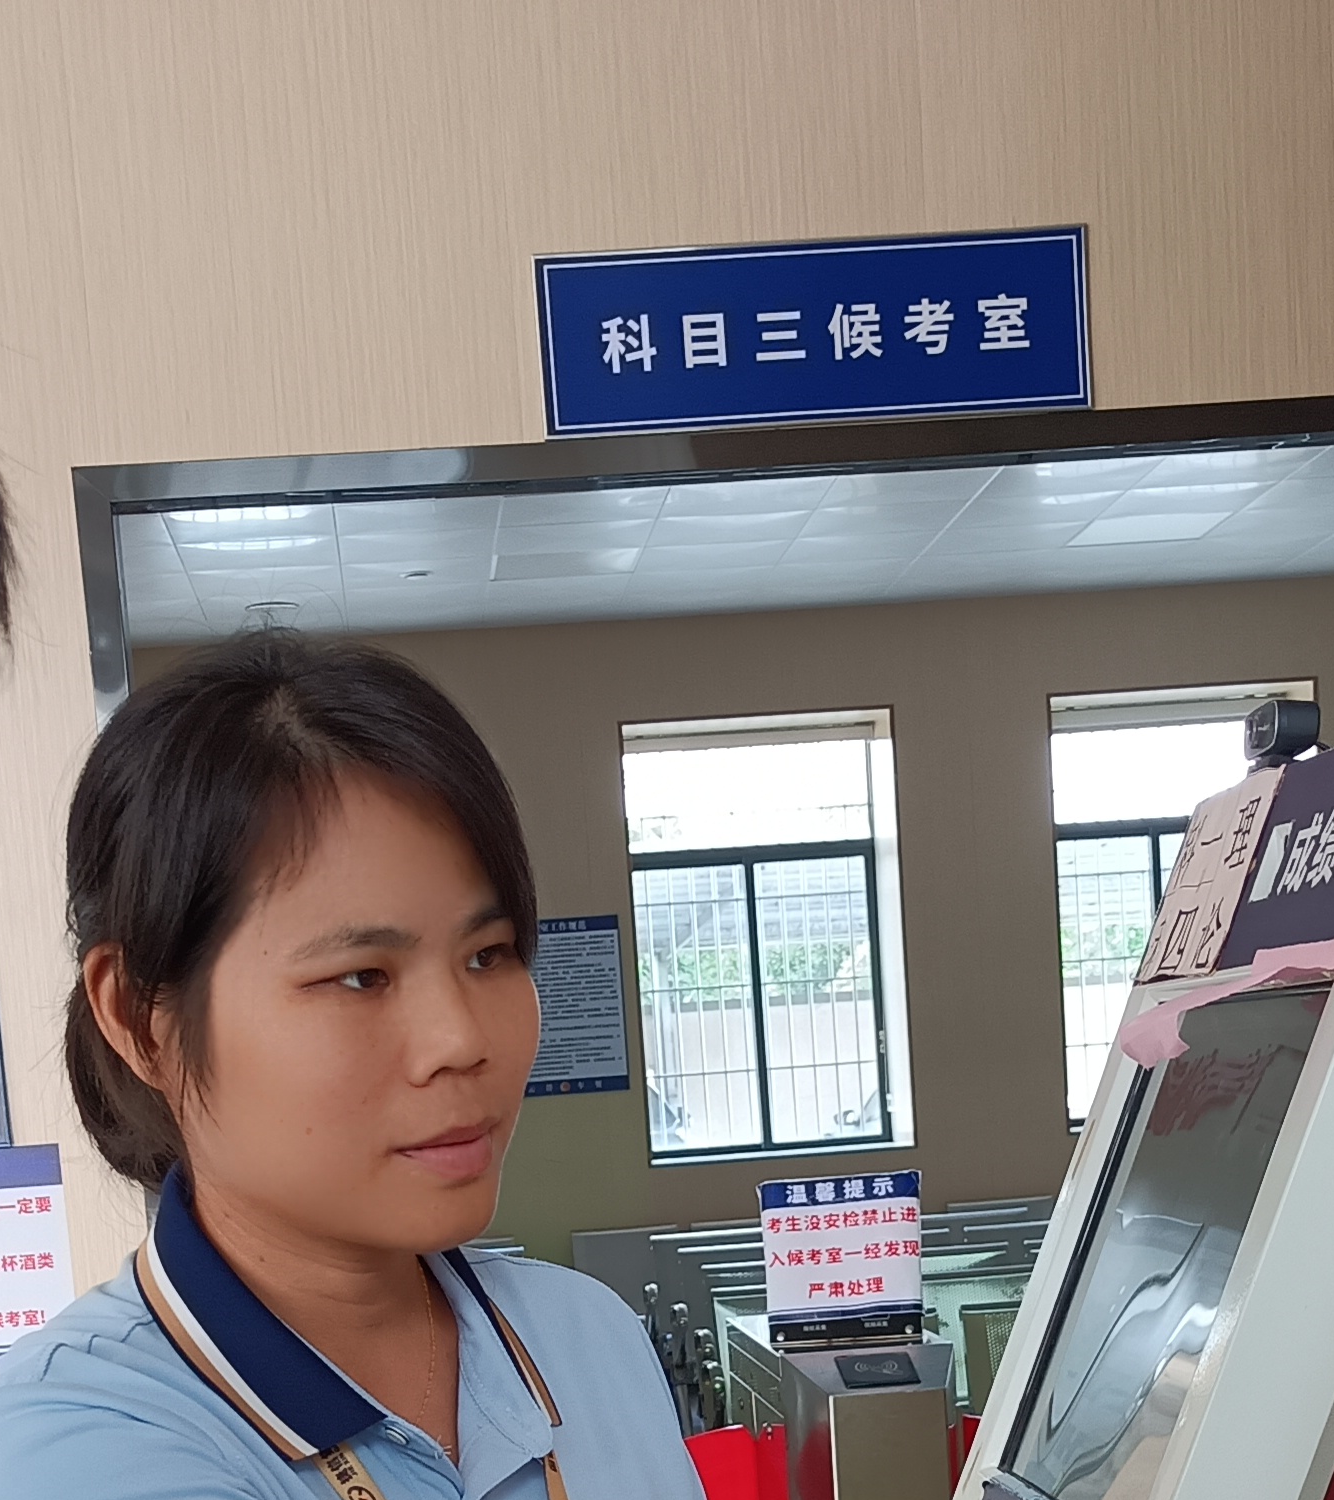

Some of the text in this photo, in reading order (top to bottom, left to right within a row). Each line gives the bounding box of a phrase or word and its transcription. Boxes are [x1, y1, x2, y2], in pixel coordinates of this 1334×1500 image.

[600, 293, 1031, 376] 科目三候考室
[786, 1176, 894, 1204] 温馨提示
[766, 1205, 918, 1234] 考生没安检禁止进
[768, 1240, 921, 1268] 入候考室一经发现
[808, 1276, 885, 1299] 严肃处理
